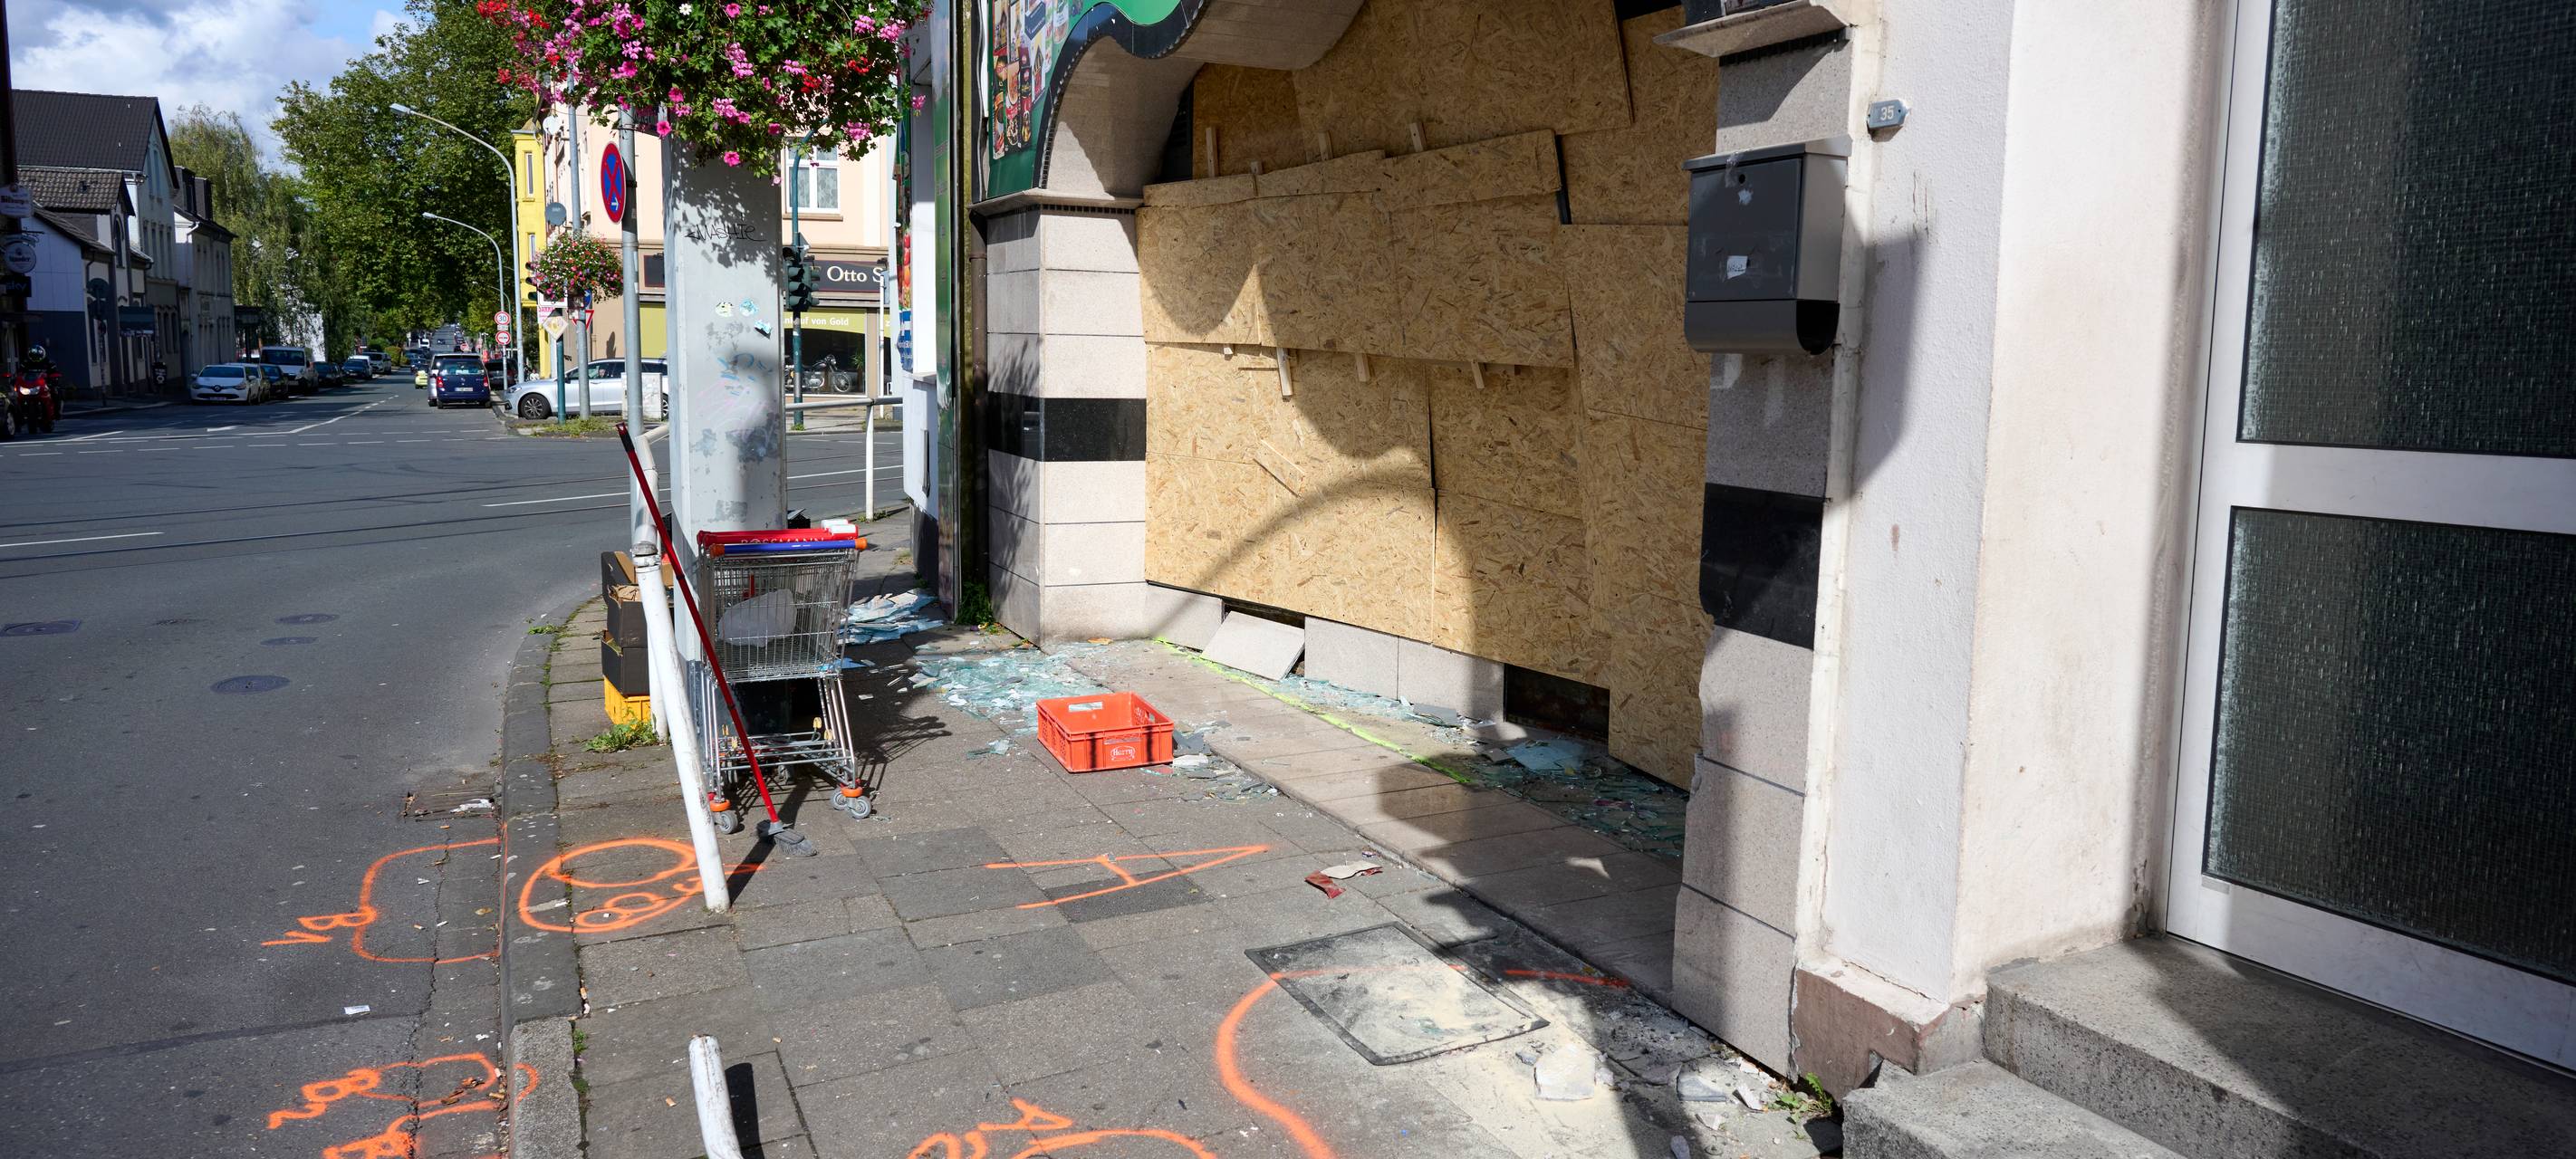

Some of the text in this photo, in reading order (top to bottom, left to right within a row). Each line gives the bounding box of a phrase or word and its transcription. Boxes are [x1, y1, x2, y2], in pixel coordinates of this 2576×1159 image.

[1880, 105, 1895, 120] 35
[827, 265, 868, 283] Otto
[830, 317, 849, 326] Gold
